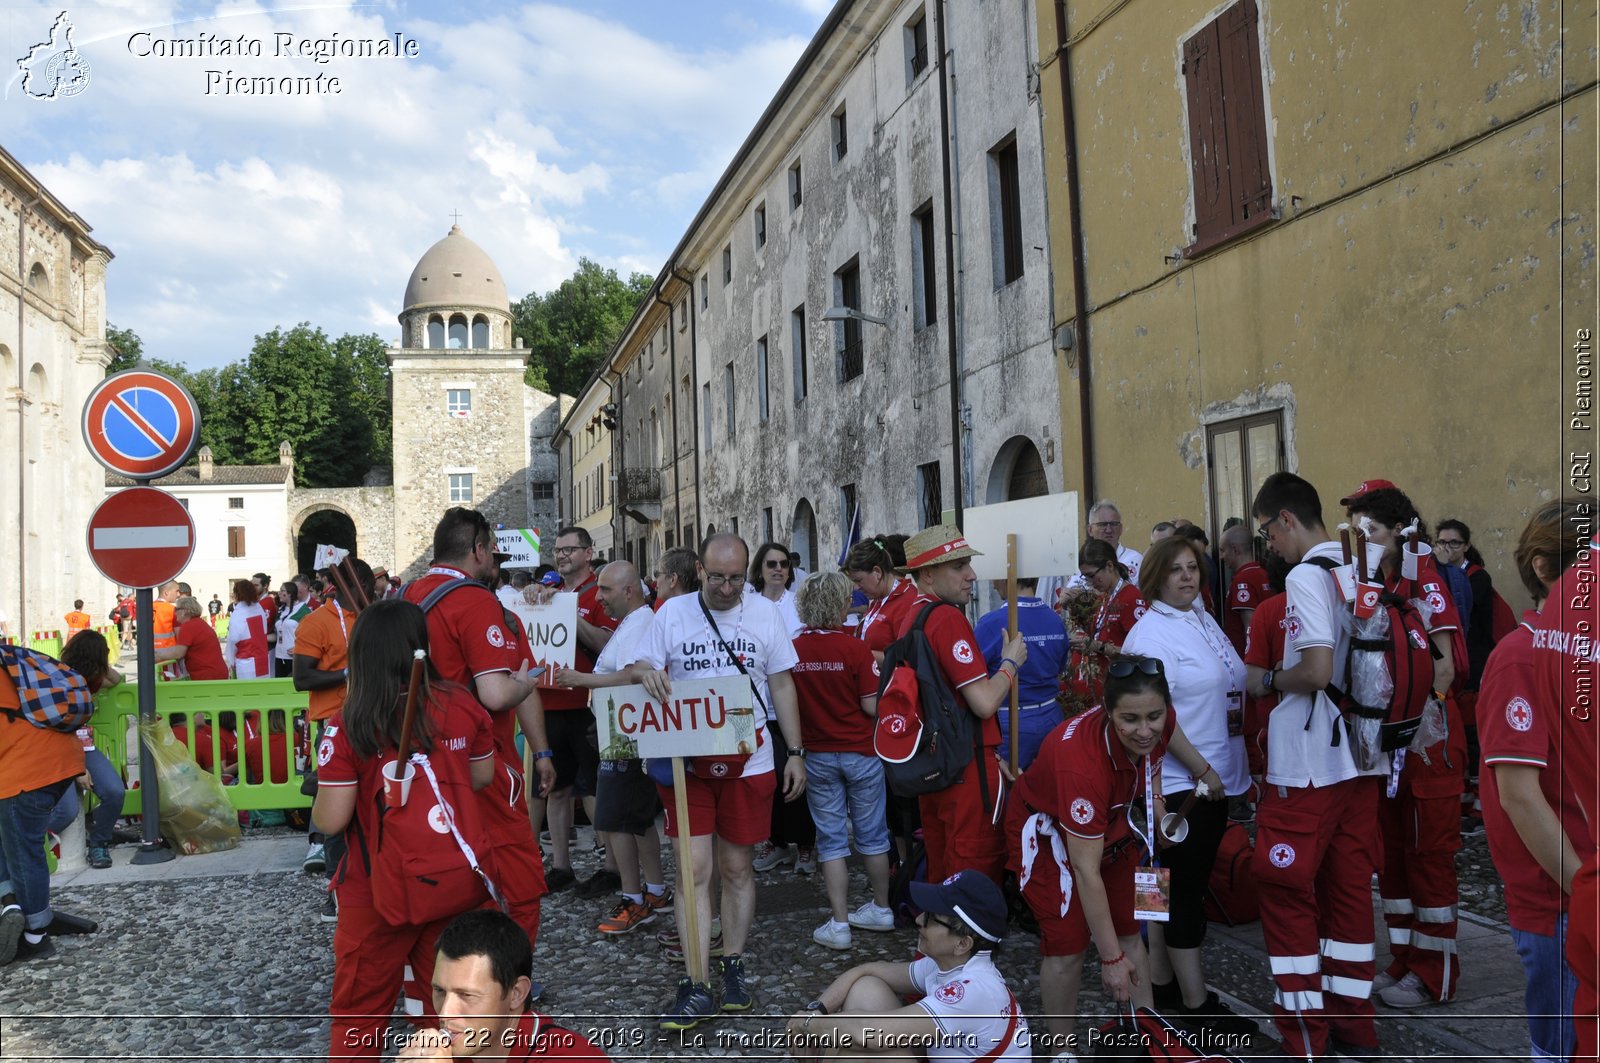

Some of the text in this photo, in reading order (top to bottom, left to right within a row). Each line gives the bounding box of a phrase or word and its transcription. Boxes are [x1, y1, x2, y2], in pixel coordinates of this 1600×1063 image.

[496, 536, 522, 544] OMITATO
[527, 622, 568, 648] ANO
[823, 661, 844, 671] ITALIANA
[618, 688, 726, 735] CANTÙ
[449, 736, 466, 751] IANA
